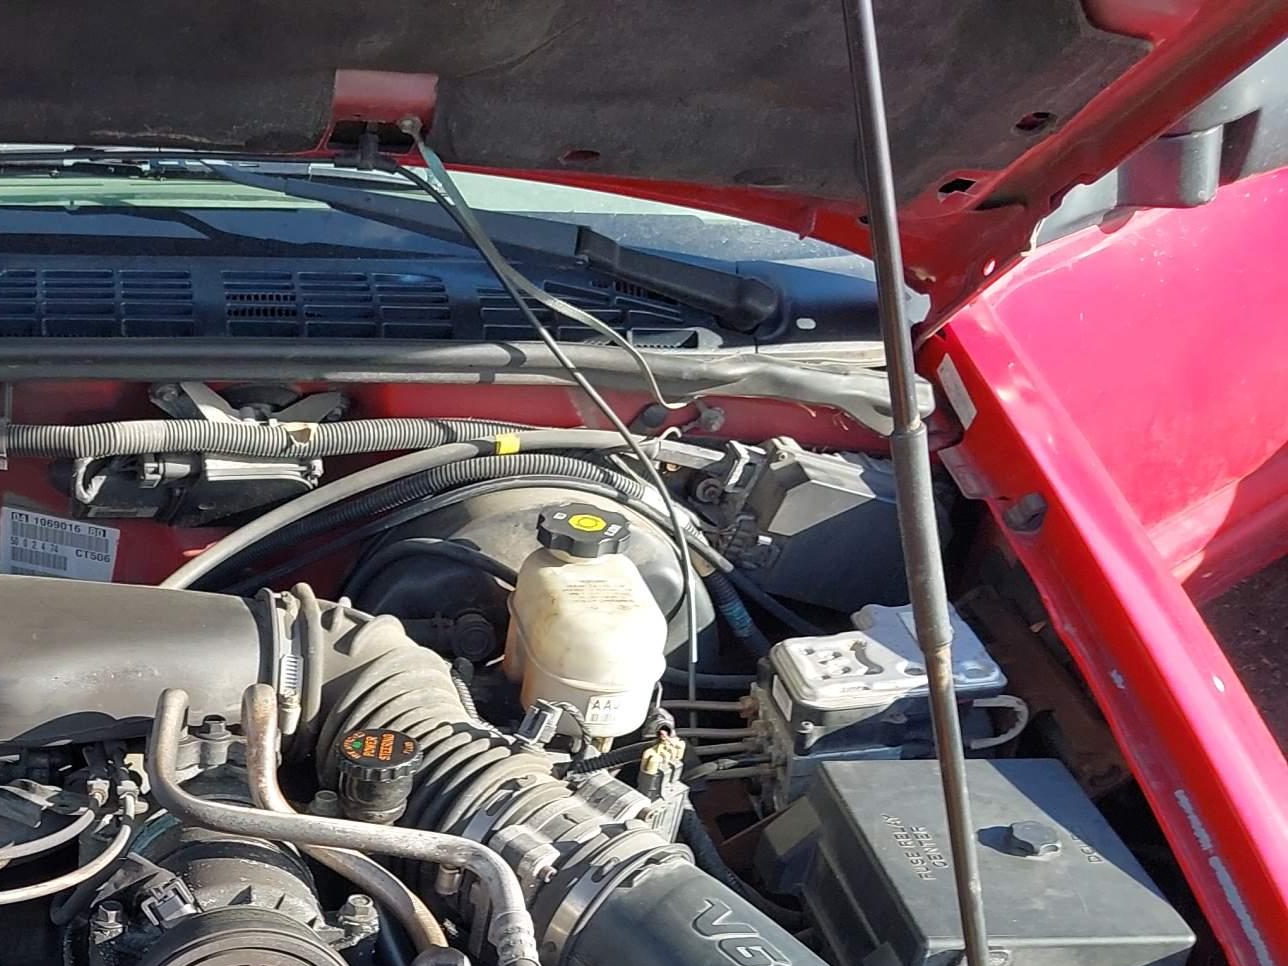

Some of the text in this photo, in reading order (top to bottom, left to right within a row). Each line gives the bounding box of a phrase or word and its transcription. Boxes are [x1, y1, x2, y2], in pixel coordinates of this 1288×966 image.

[363, 736, 378, 757] POWER
[882, 814, 936, 881] FUSE RELAY
[911, 824, 949, 869] CENTER
